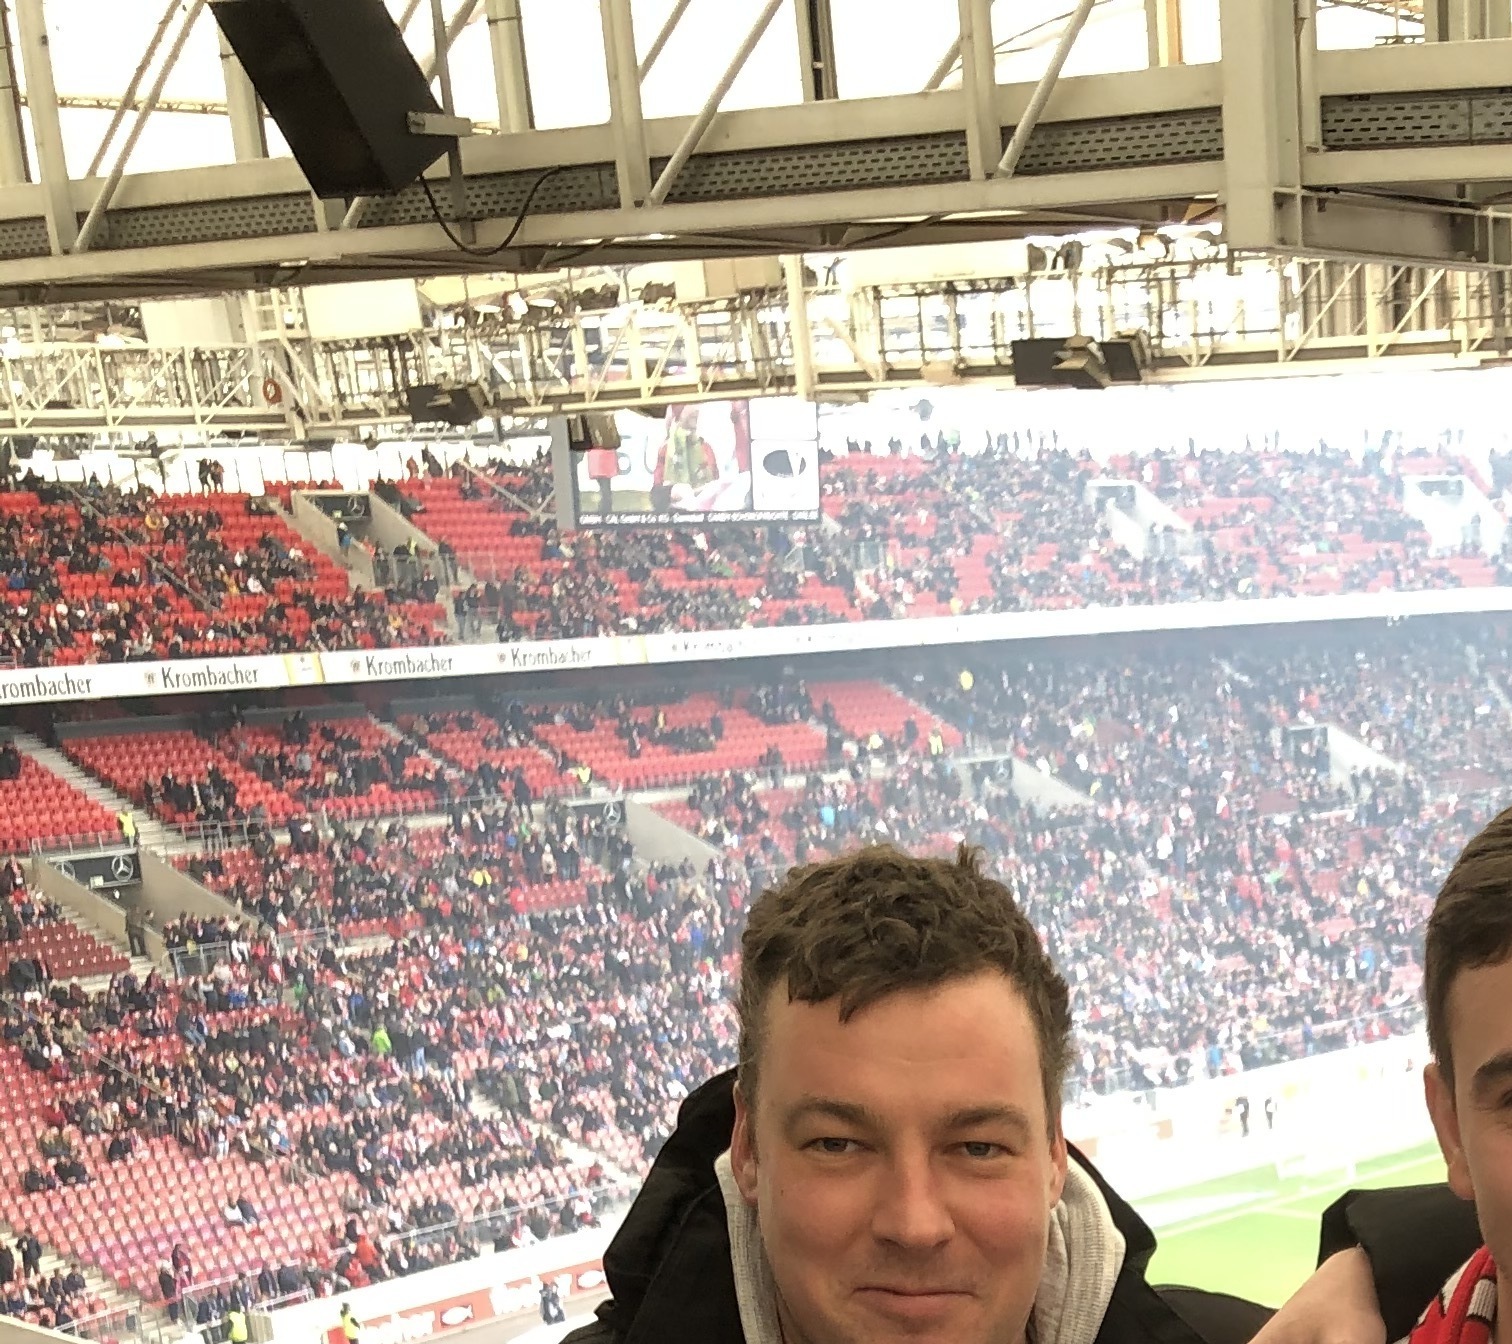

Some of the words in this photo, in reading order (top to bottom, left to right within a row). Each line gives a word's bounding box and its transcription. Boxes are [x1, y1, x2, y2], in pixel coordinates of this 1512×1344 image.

[161, 663, 259, 688] Krombacher
[366, 652, 453, 676] Krombacher
[1, 672, 92, 698] rombacher
